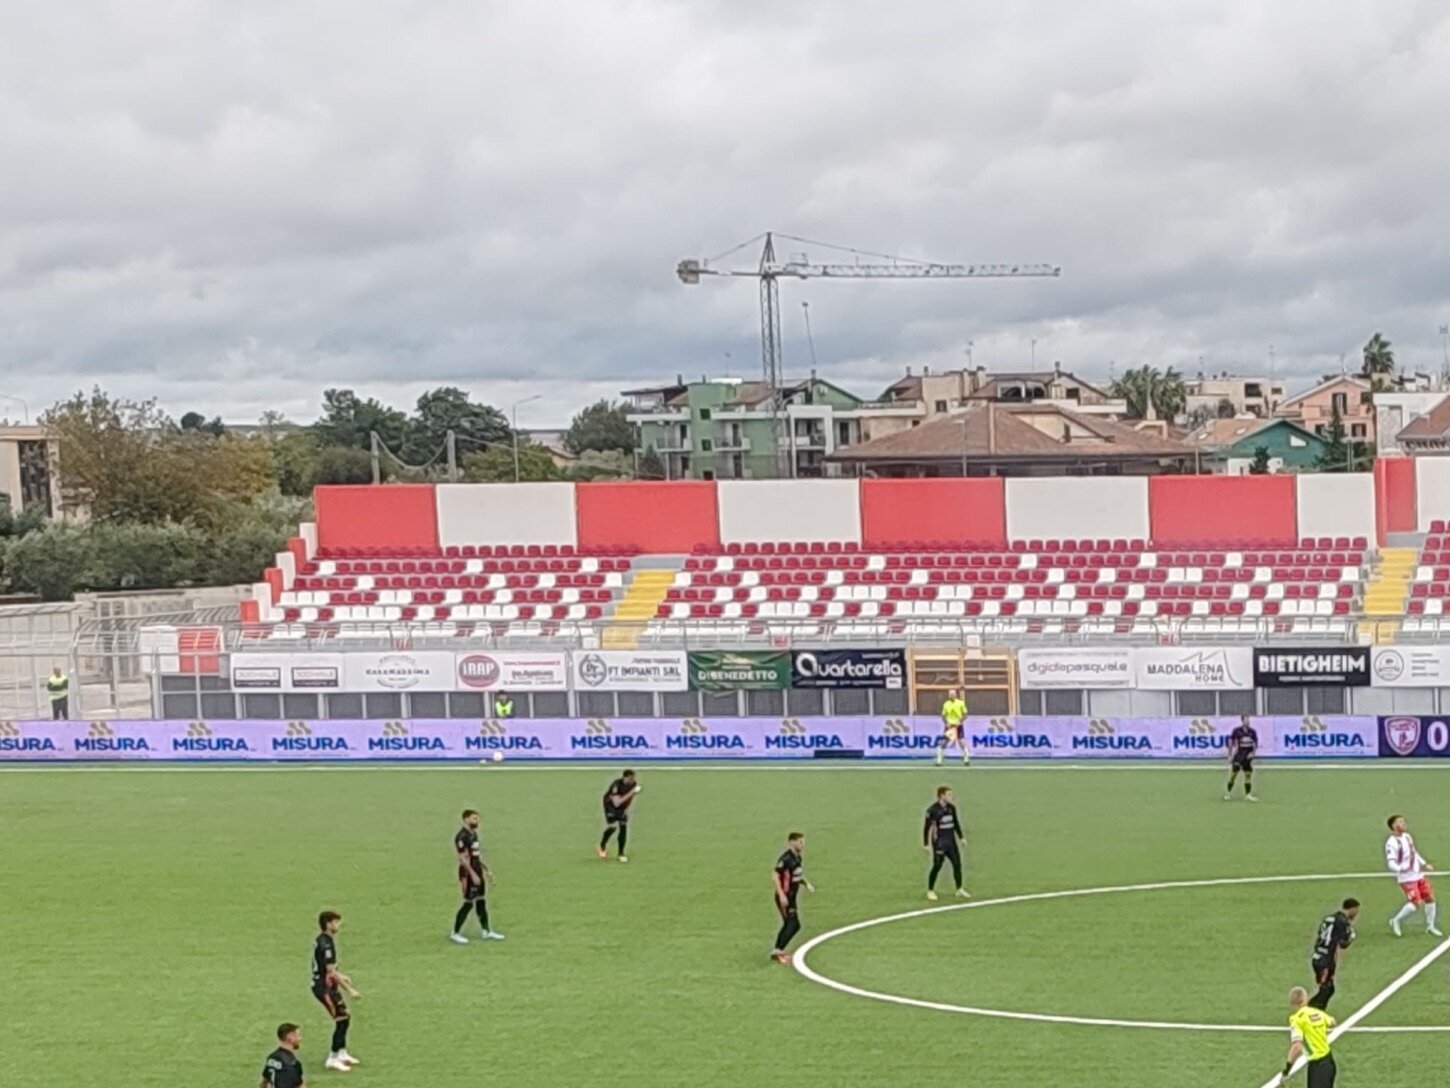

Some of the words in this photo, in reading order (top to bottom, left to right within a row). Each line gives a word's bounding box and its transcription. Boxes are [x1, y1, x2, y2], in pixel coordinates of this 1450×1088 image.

[621, 666, 661, 676] IMPIANTI
[796, 653, 902, 677] Quartarella
[1147, 664, 1224, 674] MADDALENA
[1258, 655, 1365, 673] BIETIGHEIM
[75, 737, 149, 751] MISURA
[173, 737, 249, 751] MISURA
[272, 737, 348, 751] MISURA
[368, 737, 445, 751] MISURA
[466, 736, 542, 750] MISURA
[571, 735, 649, 749] MISURA
[667, 735, 745, 749] MISURA
[765, 735, 843, 749] MISURA
[972, 735, 1052, 748] MISURA
[1073, 736, 1152, 749] MISURA
[1174, 735, 1236, 749] MISU
[1285, 733, 1364, 747] MISURA
